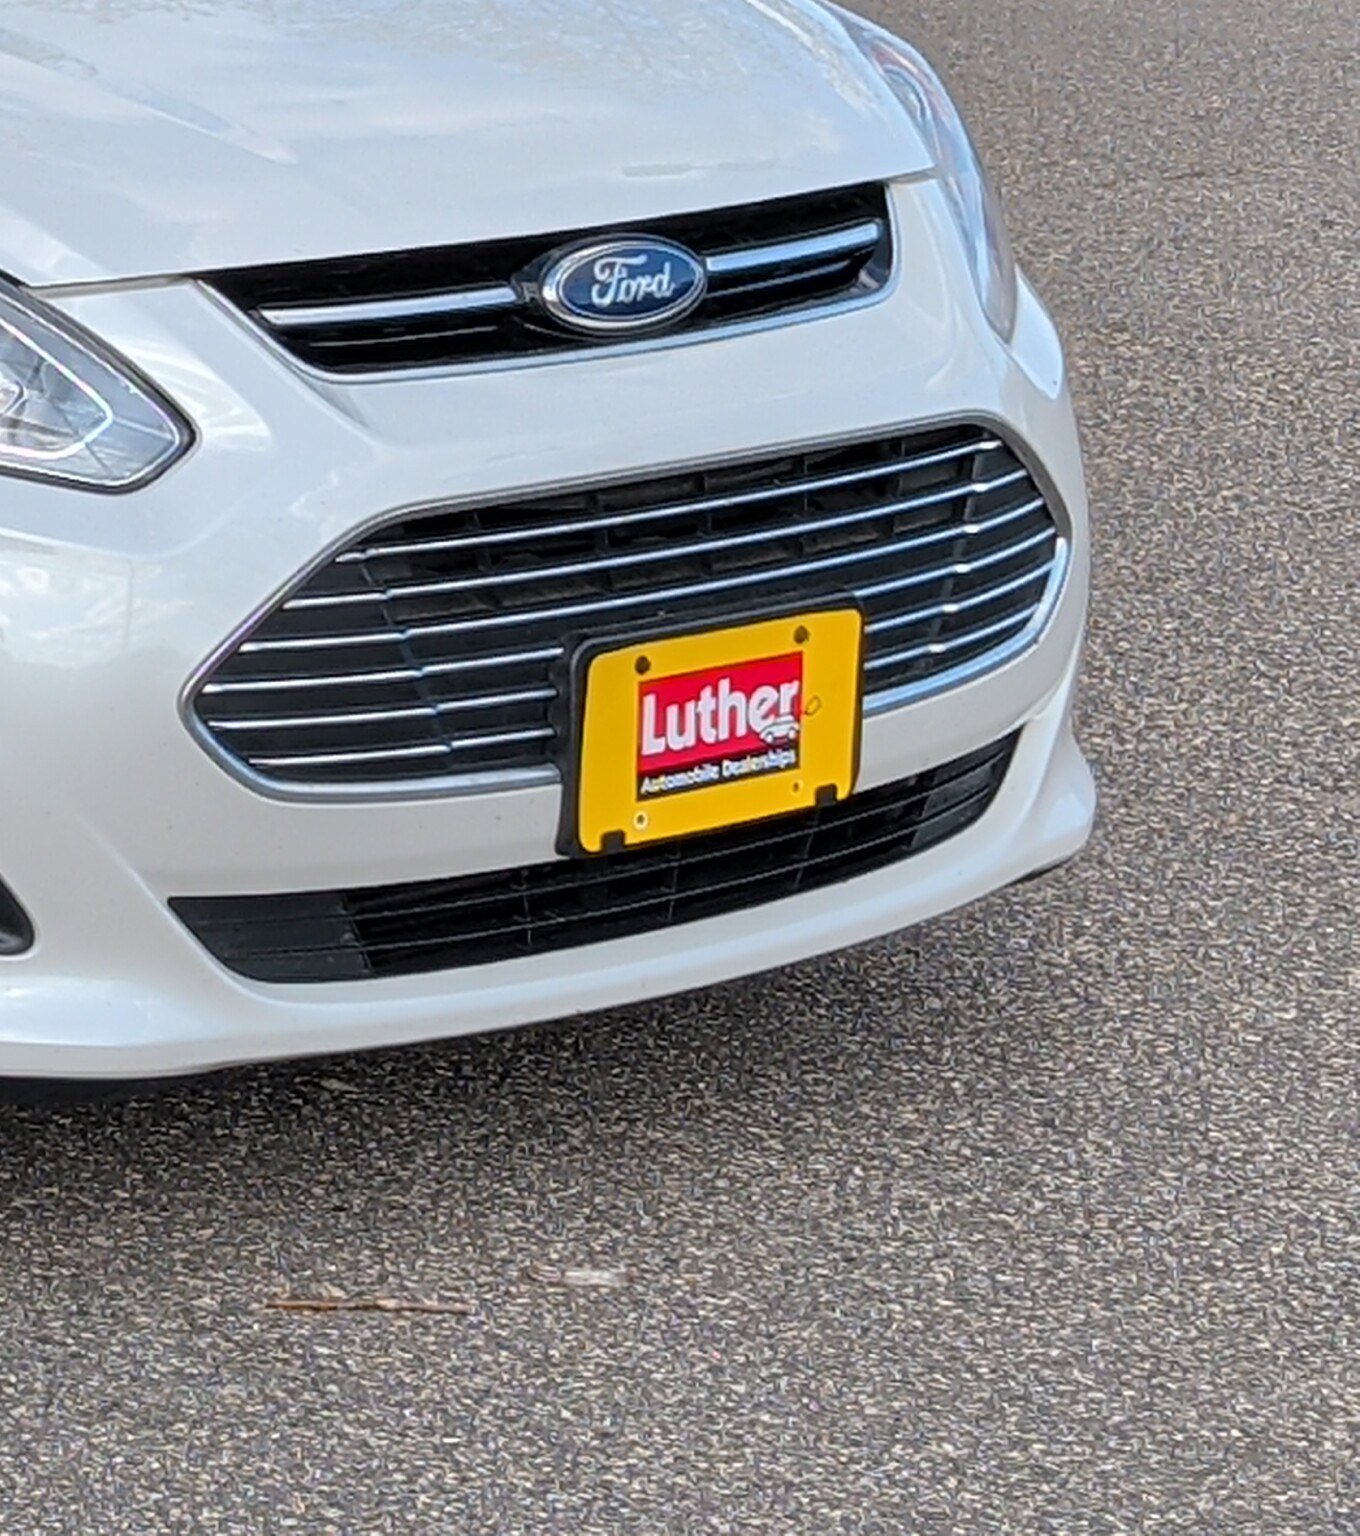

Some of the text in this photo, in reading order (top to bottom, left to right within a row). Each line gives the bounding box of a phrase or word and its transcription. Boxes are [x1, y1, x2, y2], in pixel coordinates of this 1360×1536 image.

[591, 253, 677, 308] Ford
[640, 676, 800, 757] Luther
[639, 748, 797, 795] Automobile Dealerships
